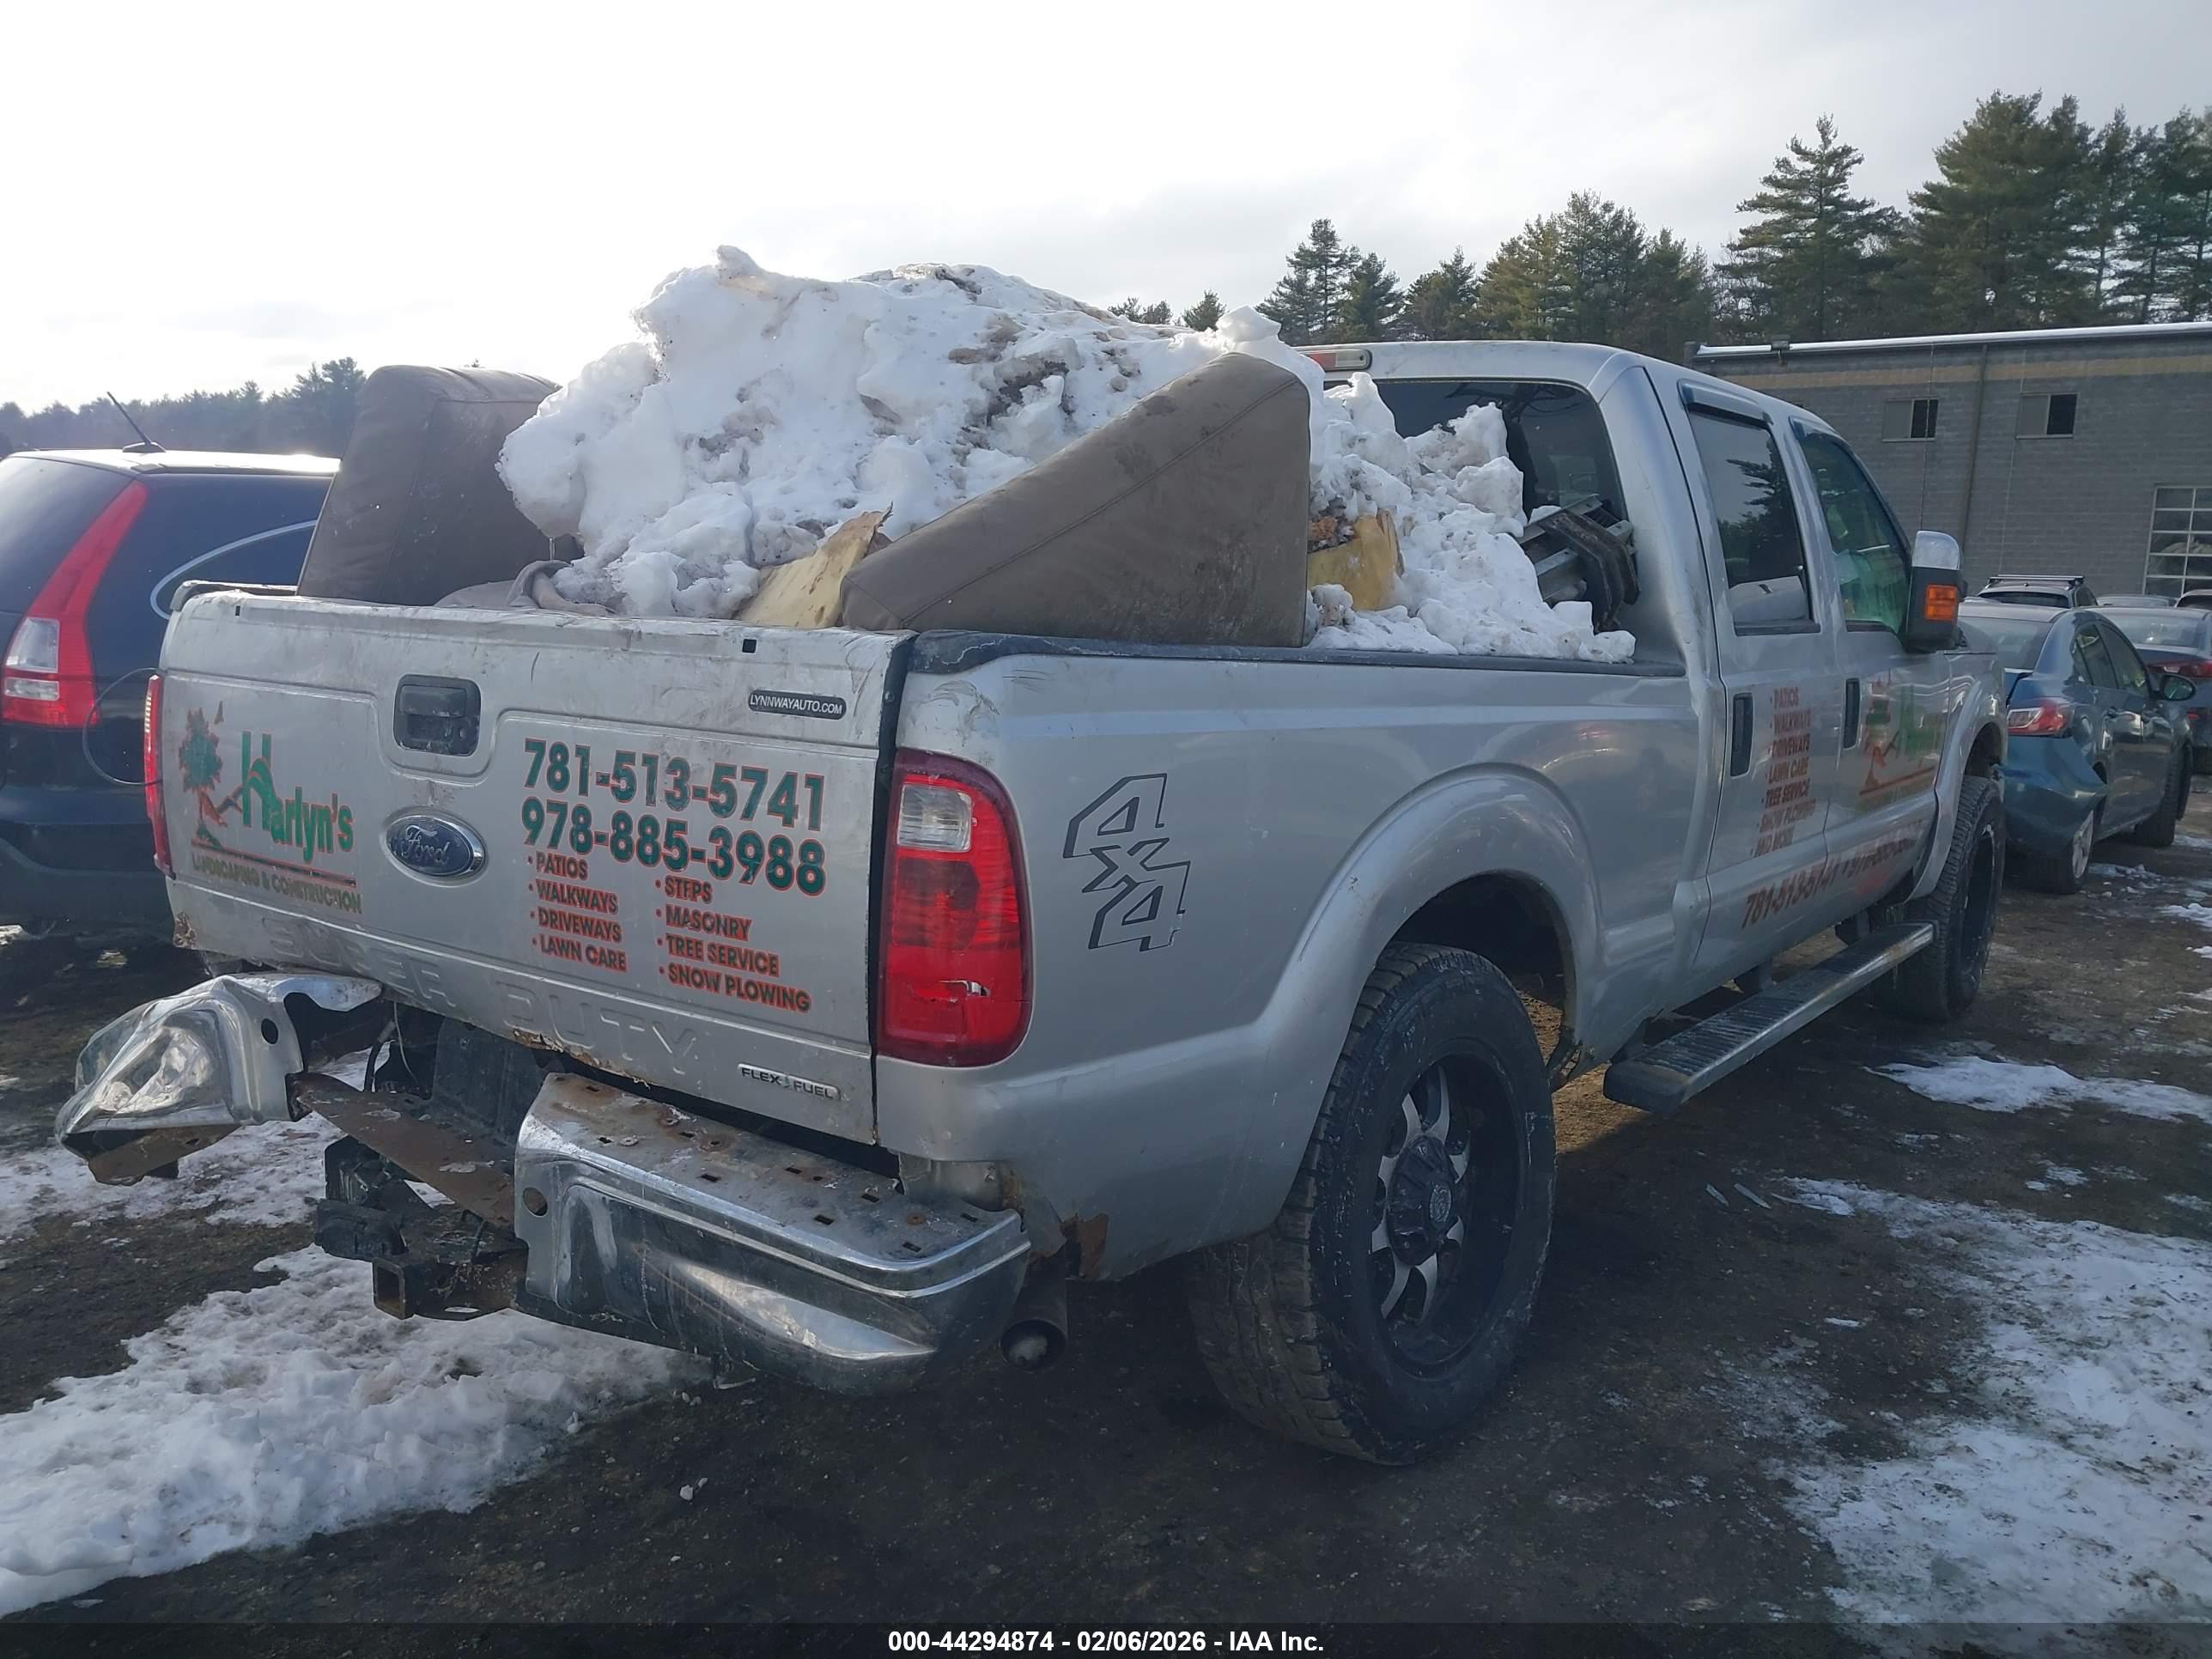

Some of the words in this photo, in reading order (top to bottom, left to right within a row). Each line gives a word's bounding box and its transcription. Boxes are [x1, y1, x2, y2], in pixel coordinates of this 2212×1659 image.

[750, 692, 844, 715] LYNNWAYAUTO.COM
[240, 730, 356, 864] Harlyn's
[524, 738, 824, 831] 781-513-5741
[400, 823, 452, 865] Ford
[521, 796, 826, 896] 978-885-3988
[535, 851, 588, 881] PATIOS
[535, 878, 619, 915] WALKWAYS
[664, 874, 714, 904] STEPS
[537, 906, 623, 944] DRIVEWAYS
[665, 903, 753, 942] MASONRY
[539, 933, 583, 963] LAWN
[584, 943, 628, 973] CARE
[665, 933, 705, 963] TREE
[706, 941, 781, 978] SERVICE
[668, 962, 722, 994] SNOW
[724, 970, 812, 1014] PLOWING
[741, 1067, 782, 1086] FLEX
[793, 1080, 835, 1100] FUEL
